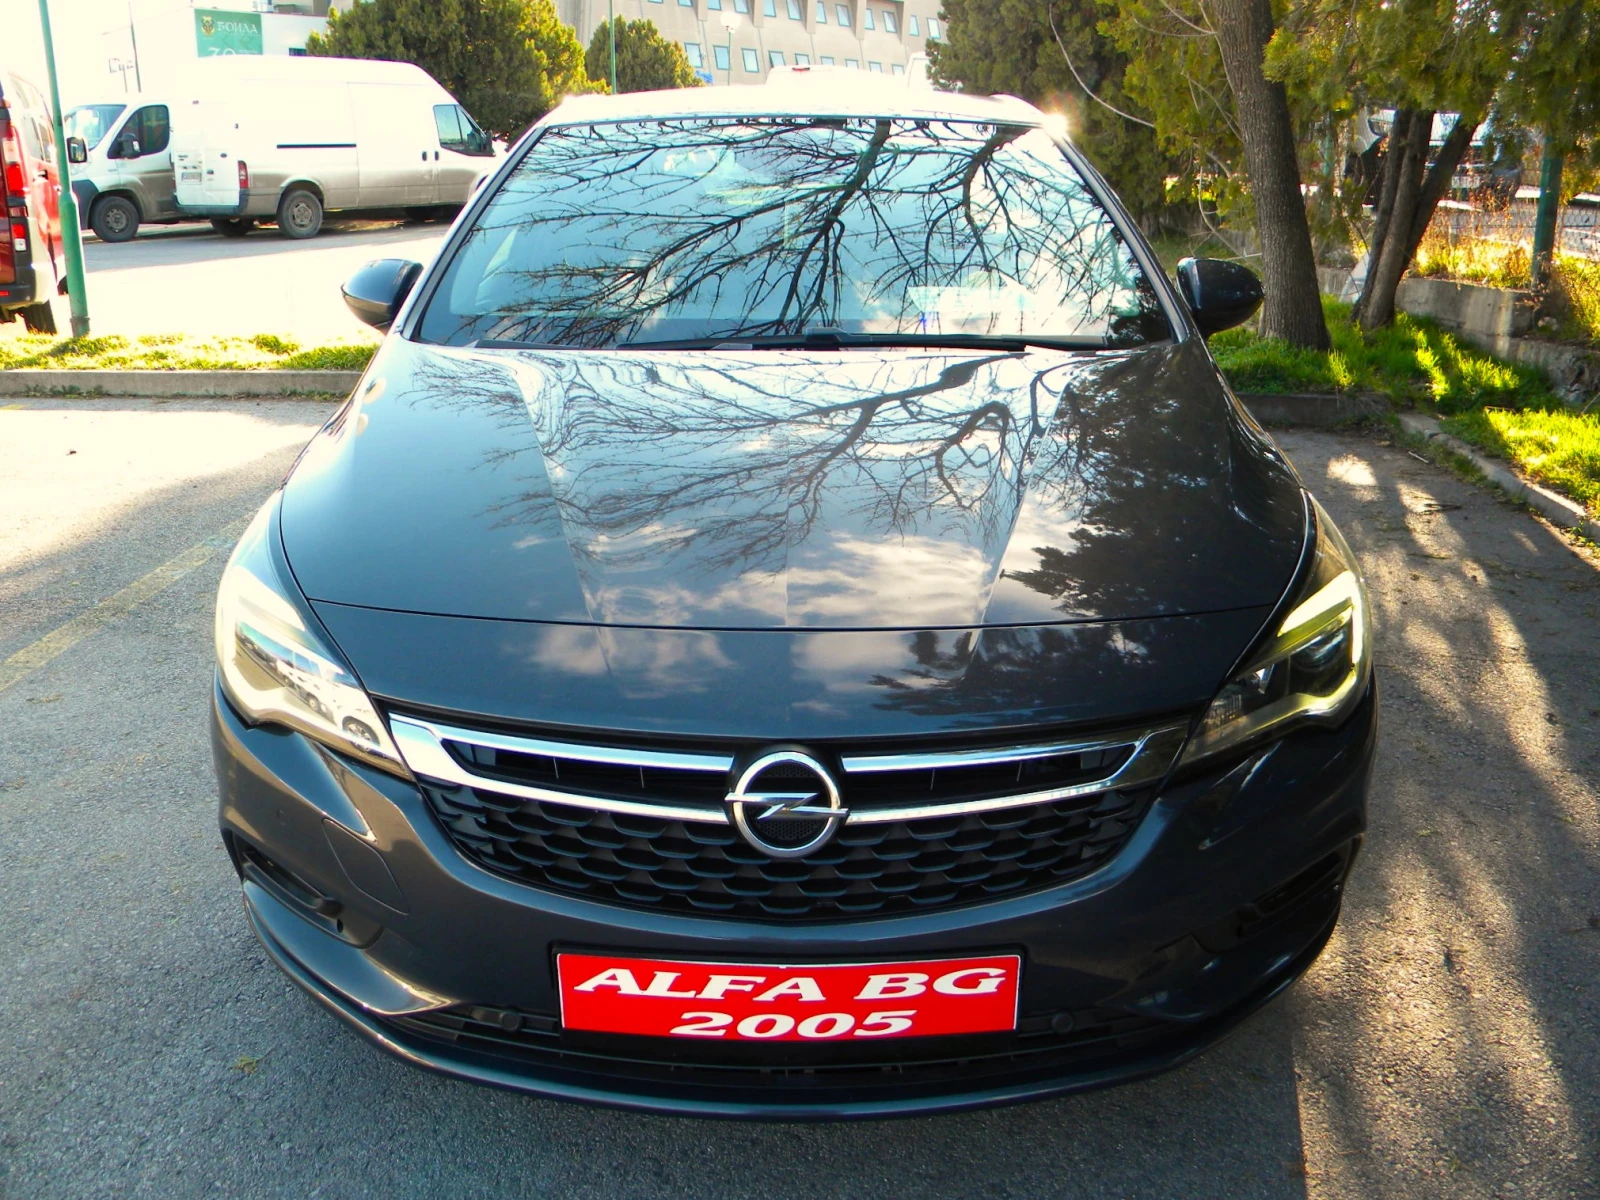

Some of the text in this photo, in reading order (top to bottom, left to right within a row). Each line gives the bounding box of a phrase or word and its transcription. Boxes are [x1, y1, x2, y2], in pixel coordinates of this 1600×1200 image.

[574, 968, 1006, 1001] ALFA BG
[669, 1010, 917, 1038] 2005
